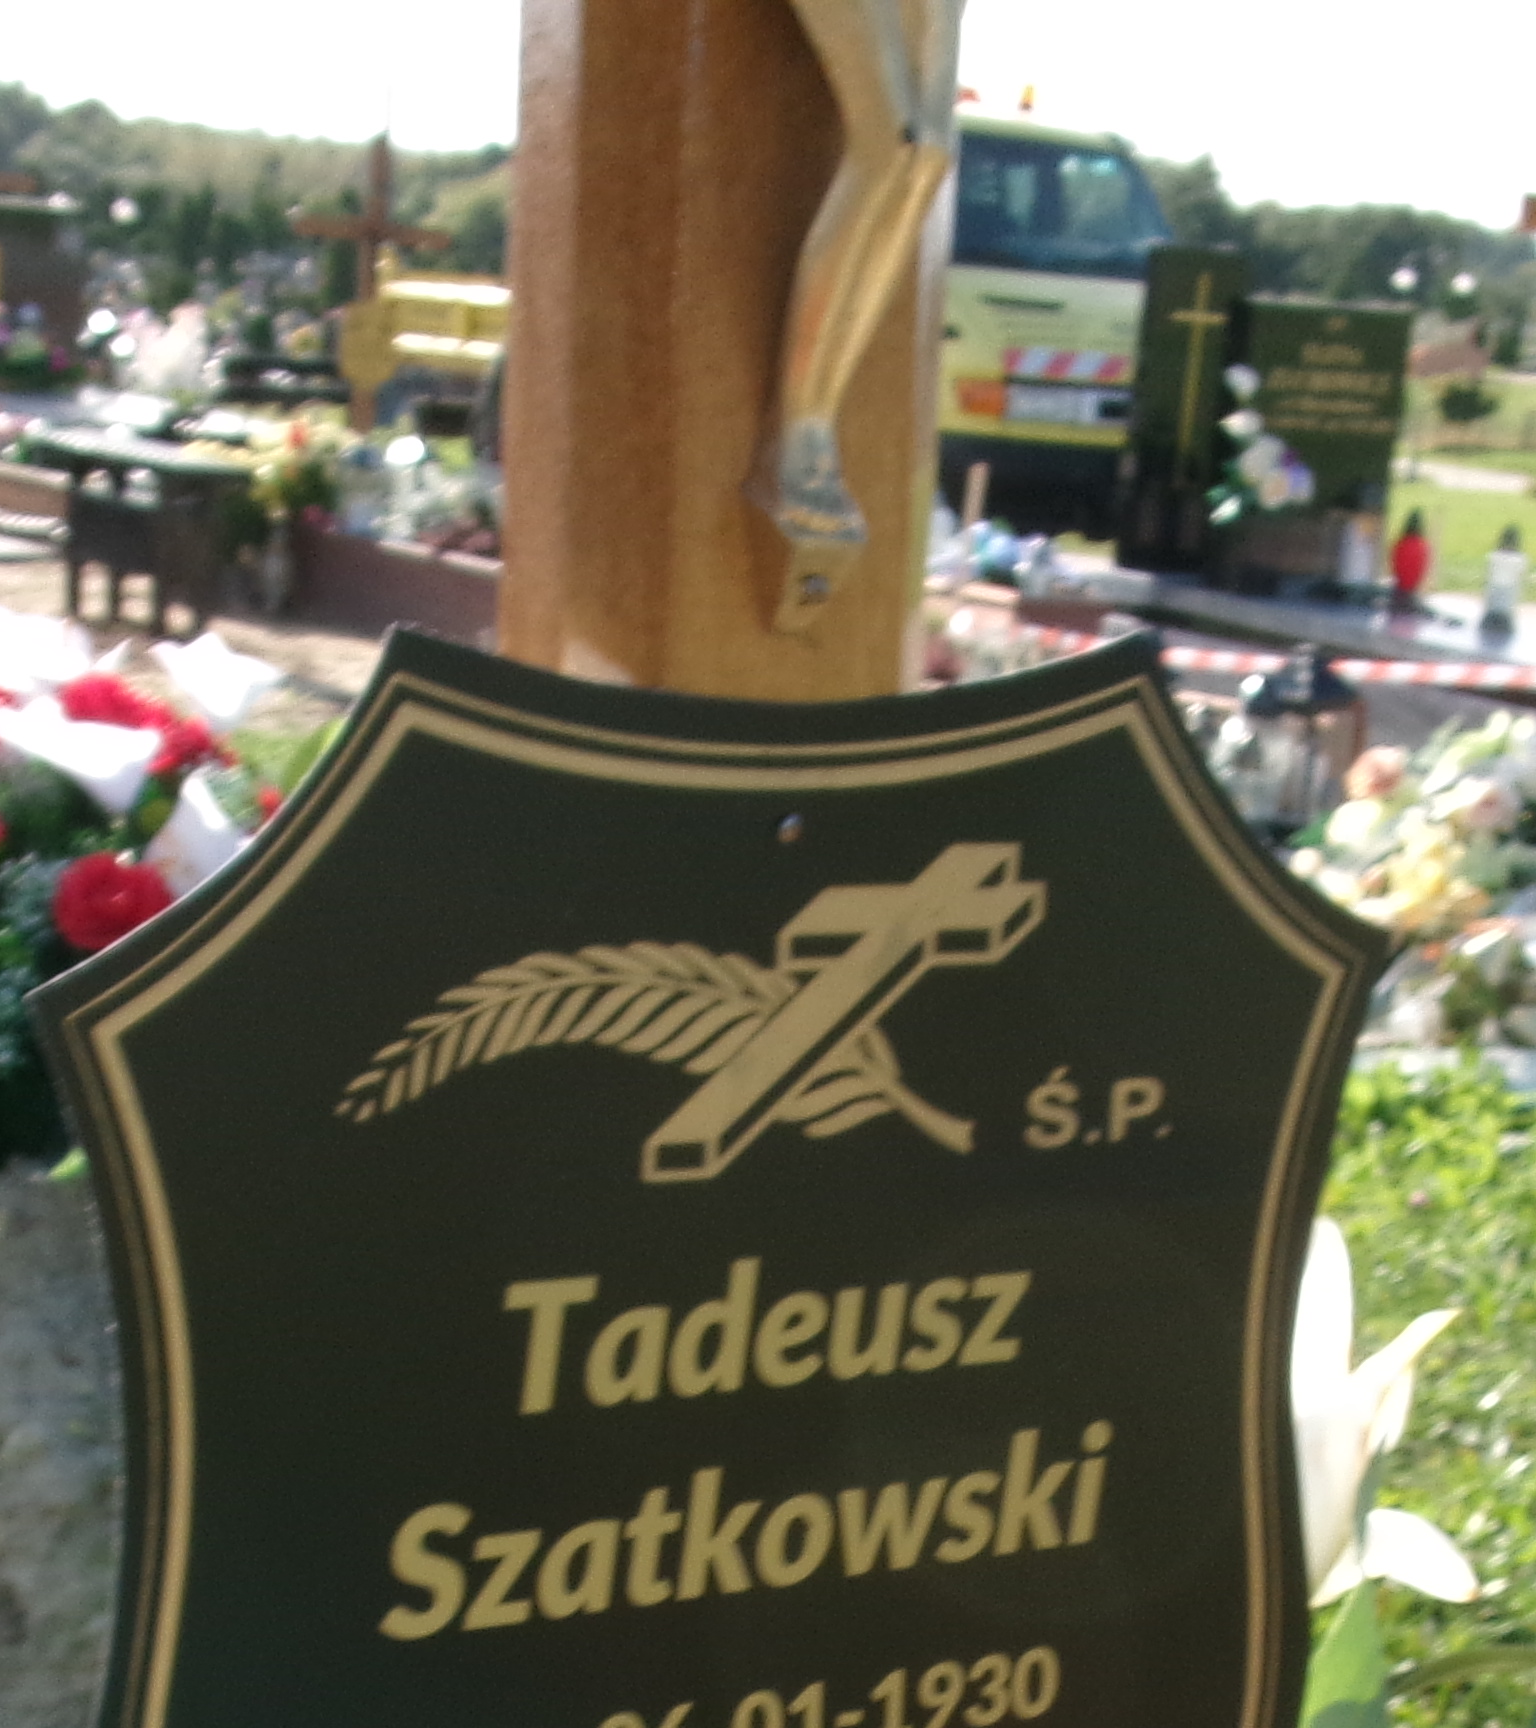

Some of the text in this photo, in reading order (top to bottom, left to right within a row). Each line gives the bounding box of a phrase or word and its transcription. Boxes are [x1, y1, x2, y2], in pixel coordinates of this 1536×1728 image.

[1023, 1065, 1174, 1149] Ś.P.
[503, 1257, 1032, 1415] Tadeusz
[378, 1419, 1114, 1641] Szatkowski
